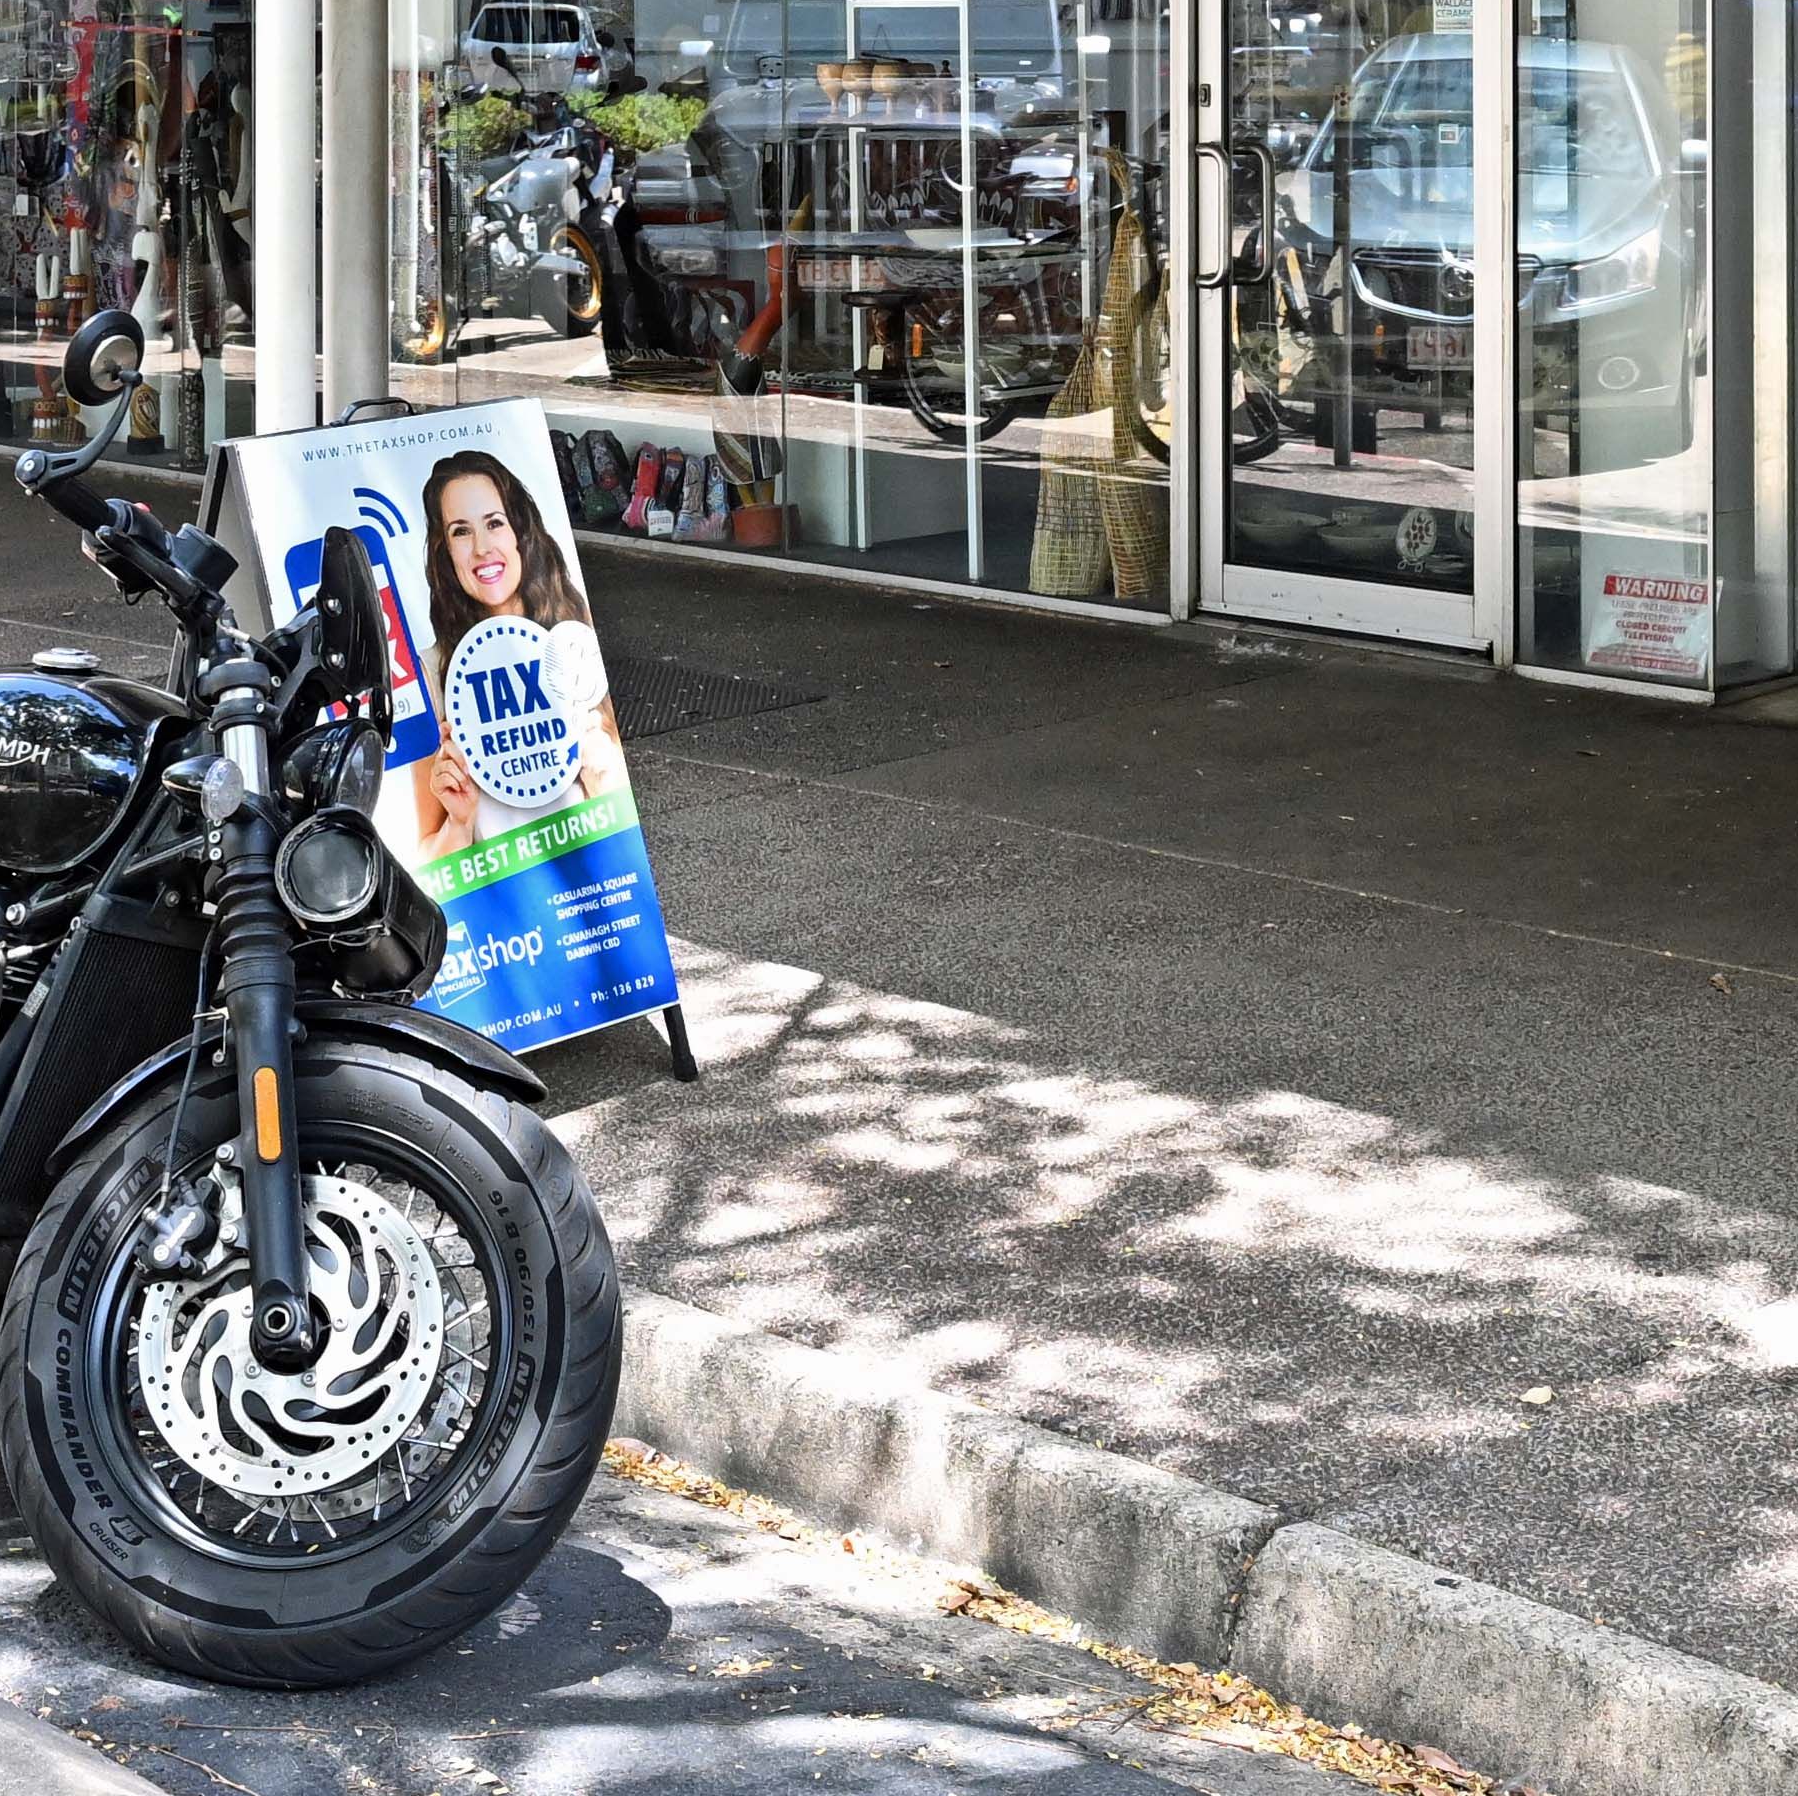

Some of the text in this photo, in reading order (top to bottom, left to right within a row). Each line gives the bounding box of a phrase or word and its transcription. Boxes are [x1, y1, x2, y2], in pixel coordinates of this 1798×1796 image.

[302, 421, 495, 464] WWW.THETAXSHOP.COM.AU
[1616, 577, 1703, 600] WARNING
[1615, 620, 1687, 634] CLOSED CIRCUIT
[1624, 630, 1675, 643] TELEVISION
[465, 659, 551, 724] TAX
[481, 717, 568, 757] REFUND
[500, 747, 561, 779] CENTRE
[460, 801, 618, 884] BEST RETURNS!
[552, 872, 638, 906] CASUARINA SQUARE
[556, 890, 632, 921] SHOPPING CENTRE
[562, 914, 641, 946] CAVANAGH STREET
[479, 930, 543, 971] shop
[566, 937, 620, 962] DARWIN CBD
[438, 976, 480, 996] specialists
[591, 975, 654, 1004] Ph: 136 829
[515, 1248, 534, 1343] 130/90
[55, 1161, 154, 1511] MICHELIN COMMANDER
[448, 1357, 535, 1519] MICHELIN
[89, 1521, 128, 1562] CRUISER
